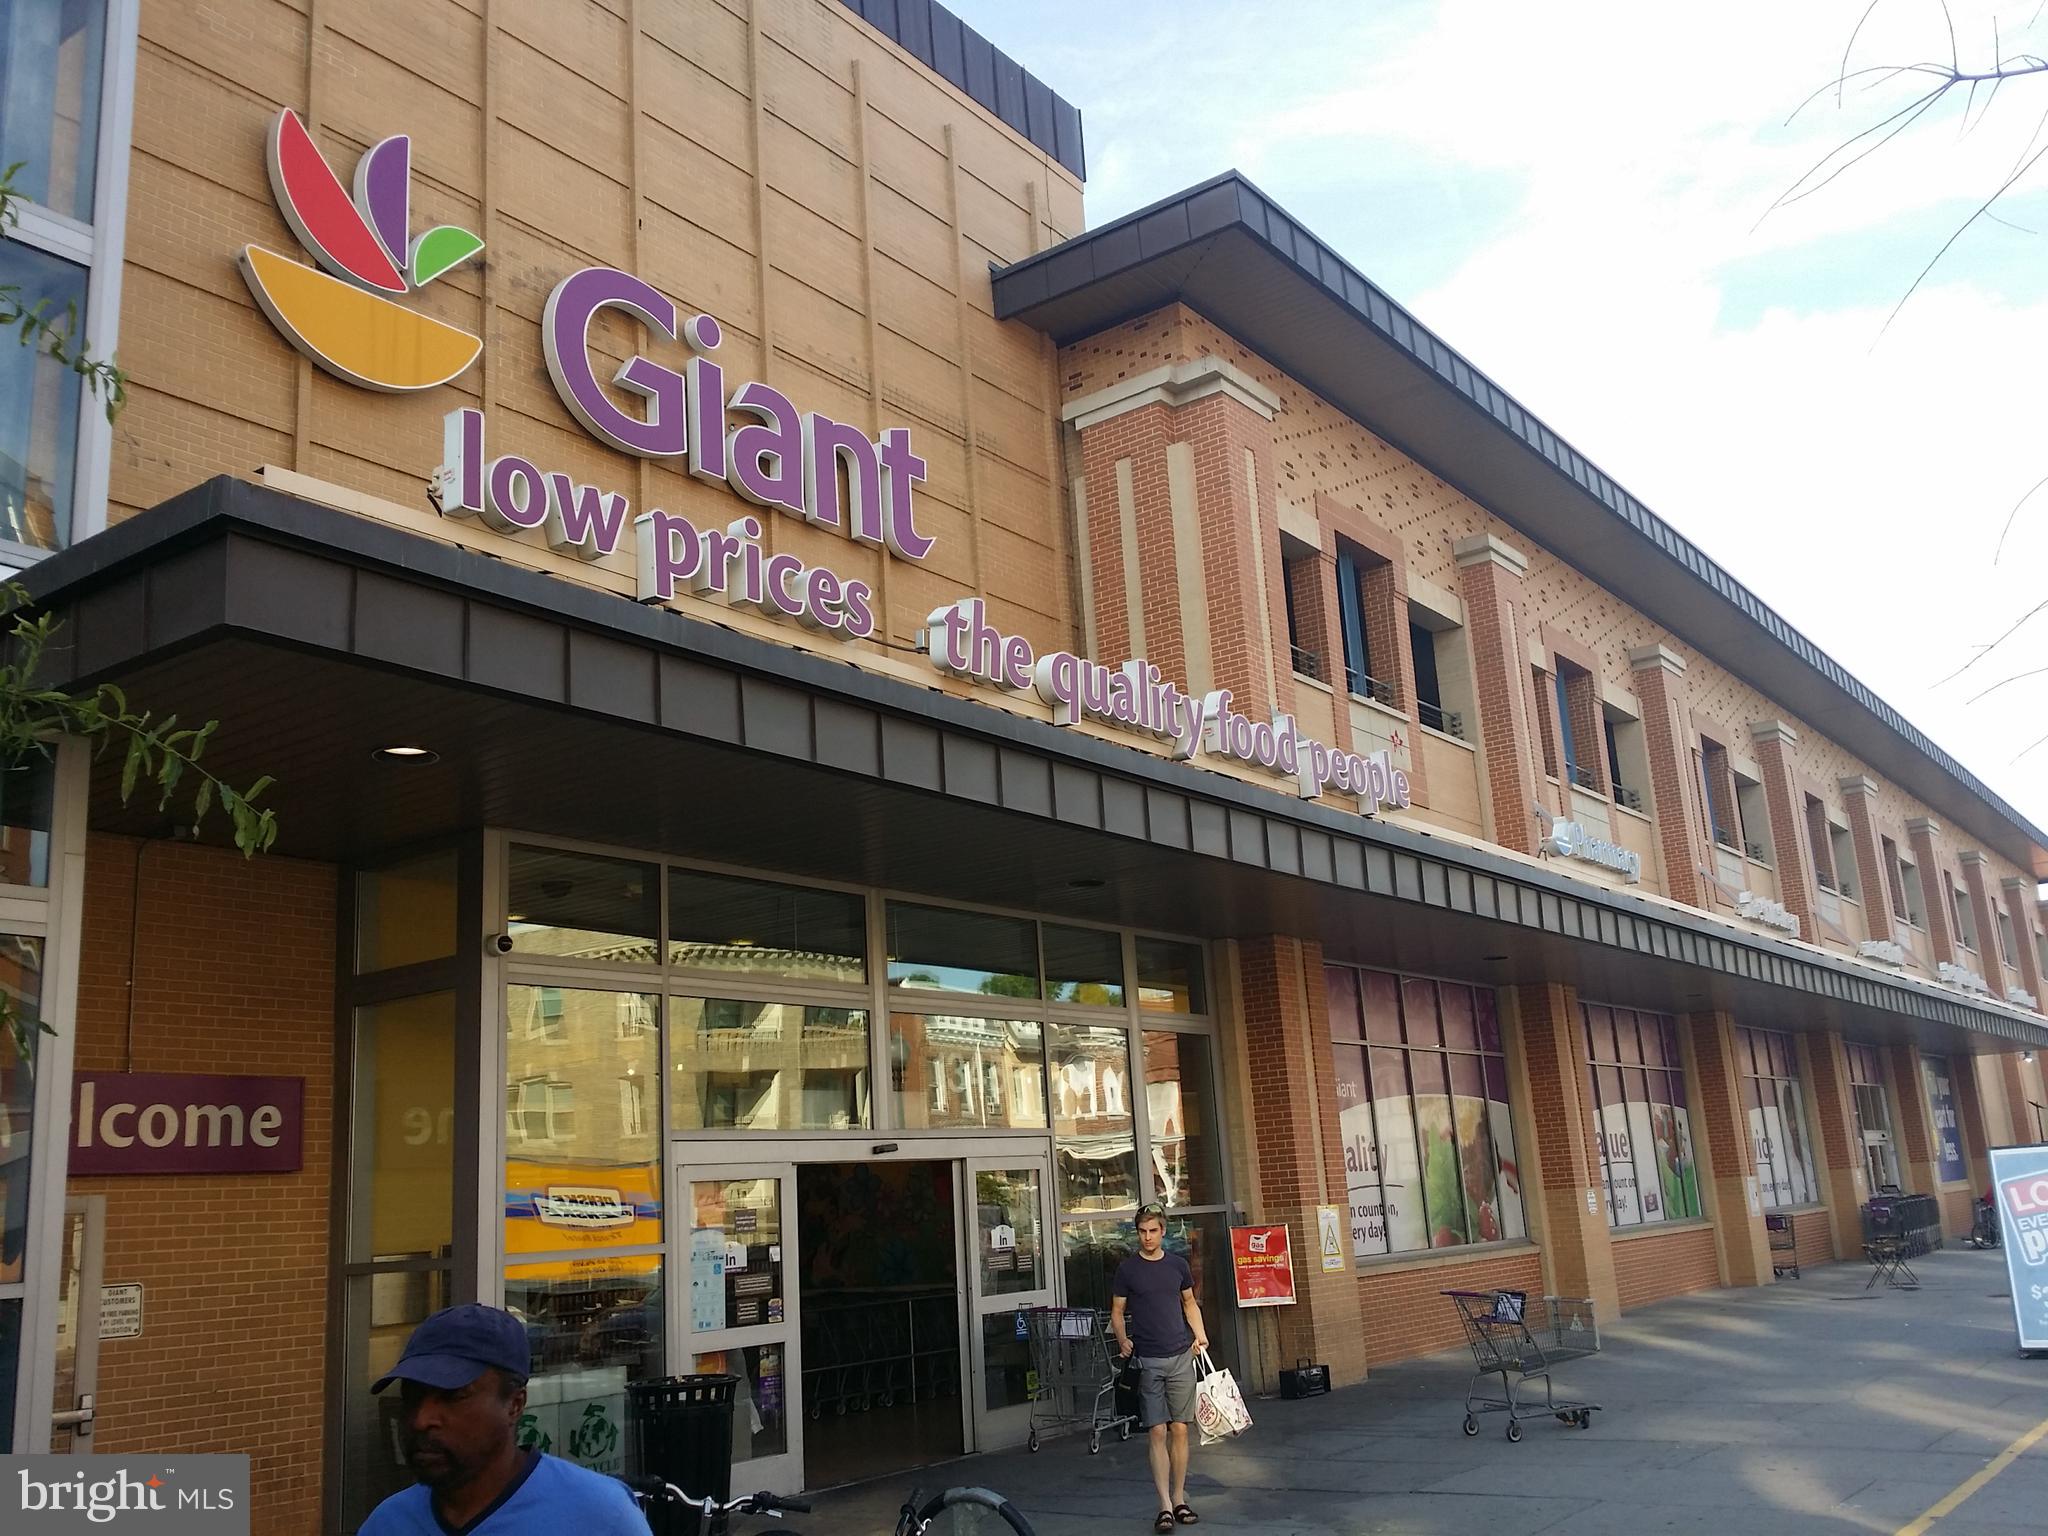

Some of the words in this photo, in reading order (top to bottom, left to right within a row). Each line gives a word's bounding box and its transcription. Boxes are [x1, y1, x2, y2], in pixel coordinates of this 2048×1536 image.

[545, 266, 937, 559] Giant
[450, 408, 629, 556] low
[640, 508, 875, 641] prices
[938, 598, 1033, 690] the
[1042, 651, 1204, 759] quality
[1210, 690, 1299, 777] food
[1303, 738, 1410, 816] people
[1336, 1079, 1357, 1098] iant
[999, 1234, 1008, 1246] In
[725, 1253, 737, 1266] In
[1237, 1256, 1252, 1265] gas
[1253, 1254, 1285, 1264] savings
